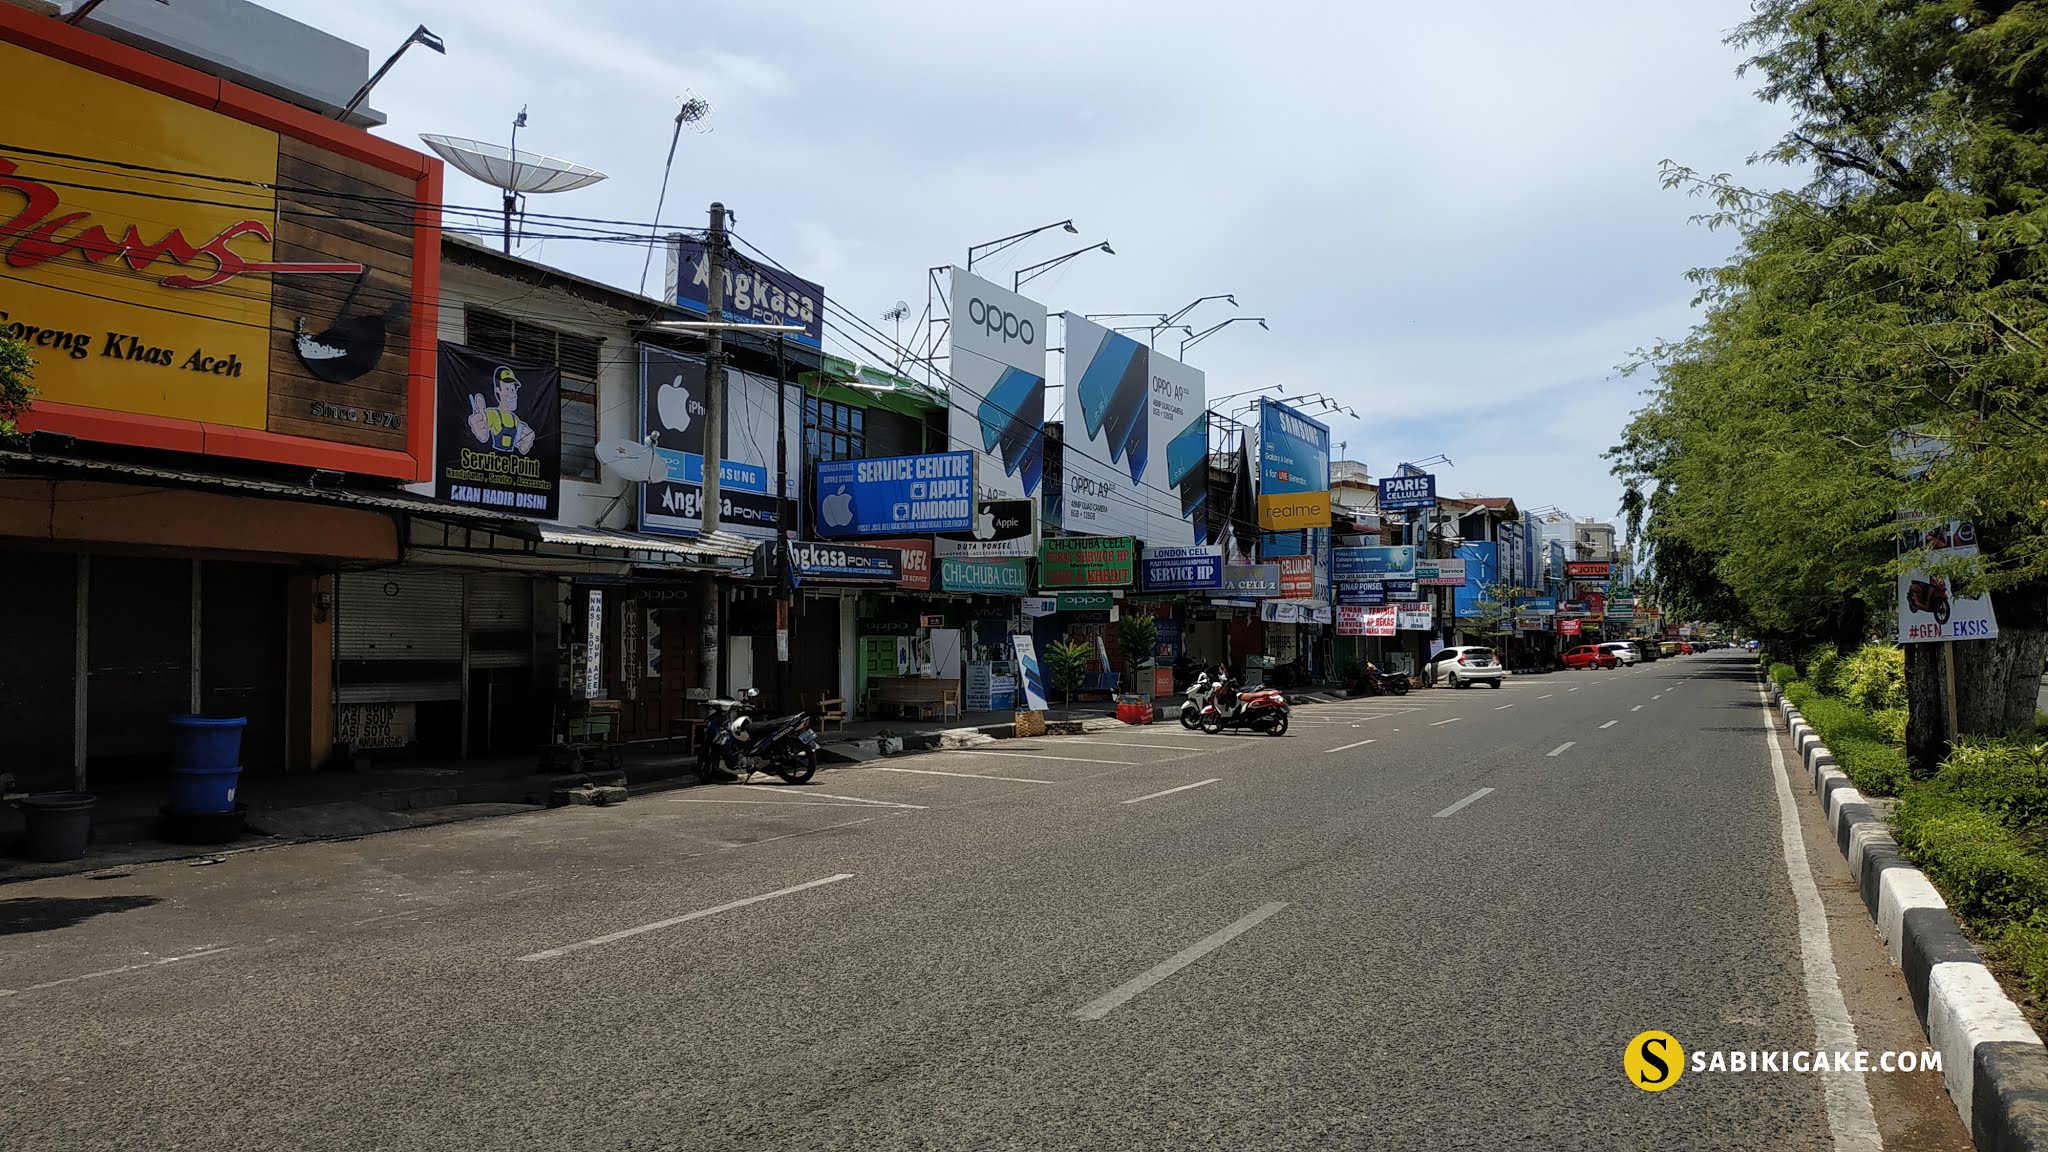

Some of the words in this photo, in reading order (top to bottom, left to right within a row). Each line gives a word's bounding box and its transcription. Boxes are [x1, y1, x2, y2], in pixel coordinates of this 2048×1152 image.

[969, 297, 1034, 345] oppo
[100, 331, 174, 367] Khas
[180, 348, 242, 378] Aceh
[1152, 376, 1172, 398] OPPO
[1174, 384, 1184, 402] A9
[312, 400, 357, 421] Since
[364, 409, 402, 429] 1970
[688, 400, 706, 416] iPh
[1279, 411, 1319, 447] SAMSUNG
[461, 447, 509, 473] Service
[510, 454, 540, 478] Point
[1264, 452, 1280, 464] Galaxy
[858, 459, 913, 483] SERVICE
[916, 455, 969, 480] CENTRE
[1269, 470, 1277, 478] for
[1279, 471, 1288, 481] LIVE
[929, 479, 969, 499] APPLE
[1071, 476, 1094, 496] OPPO
[1097, 482, 1108, 499] A9
[1386, 478, 1429, 493] PARIS
[451, 485, 480, 503] AKAN
[482, 488, 515, 507] HADIR
[516, 493, 547, 510] DISINI
[661, 484, 732, 518] Angsa
[1386, 490, 1428, 500] CELLULAR
[911, 499, 969, 520] ANDROID
[1266, 504, 1321, 519] realme
[996, 517, 1019, 529] Apple
[982, 542, 1010, 550] PONSEL
[1049, 539, 1100, 550] CHI-CHUBA
[1103, 537, 1125, 549] CELL
[771, 543, 846, 570] gkasa
[847, 557, 893, 568] PONSEL
[1076, 550, 1113, 563] SERVICE
[1117, 550, 1129, 562] HP
[1154, 549, 1187, 558] LONDON
[1189, 548, 1209, 557] CELL
[902, 552, 928, 571] NSEL
[1281, 559, 1311, 574] CELLULAR
[943, 563, 1000, 585] CHI-CHUBA
[1002, 567, 1024, 586] CELL
[1045, 570, 1072, 584] CASH
[1087, 569, 1129, 583] KREDIT
[1150, 566, 1194, 582] SERVICE
[1197, 565, 1214, 580] HP
[1238, 580, 1267, 589] CELL
[1269, 582, 1277, 590] 2
[1340, 583, 1358, 591] SINAR
[1359, 582, 1383, 590] PONSEL
[1064, 596, 1106, 605] oppo
[1399, 603, 1430, 612] CELLULAR
[1368, 607, 1395, 616] TERIMA
[866, 622, 908, 631] oppo
[1375, 618, 1394, 627] BEKAS
[340, 704, 361, 714] ASI
[340, 713, 360, 725] ASI
[366, 713, 394, 725] SOUP
[340, 725, 359, 737] ASI
[363, 725, 391, 737] SOTO
[772, 725, 795, 742] HONDA
